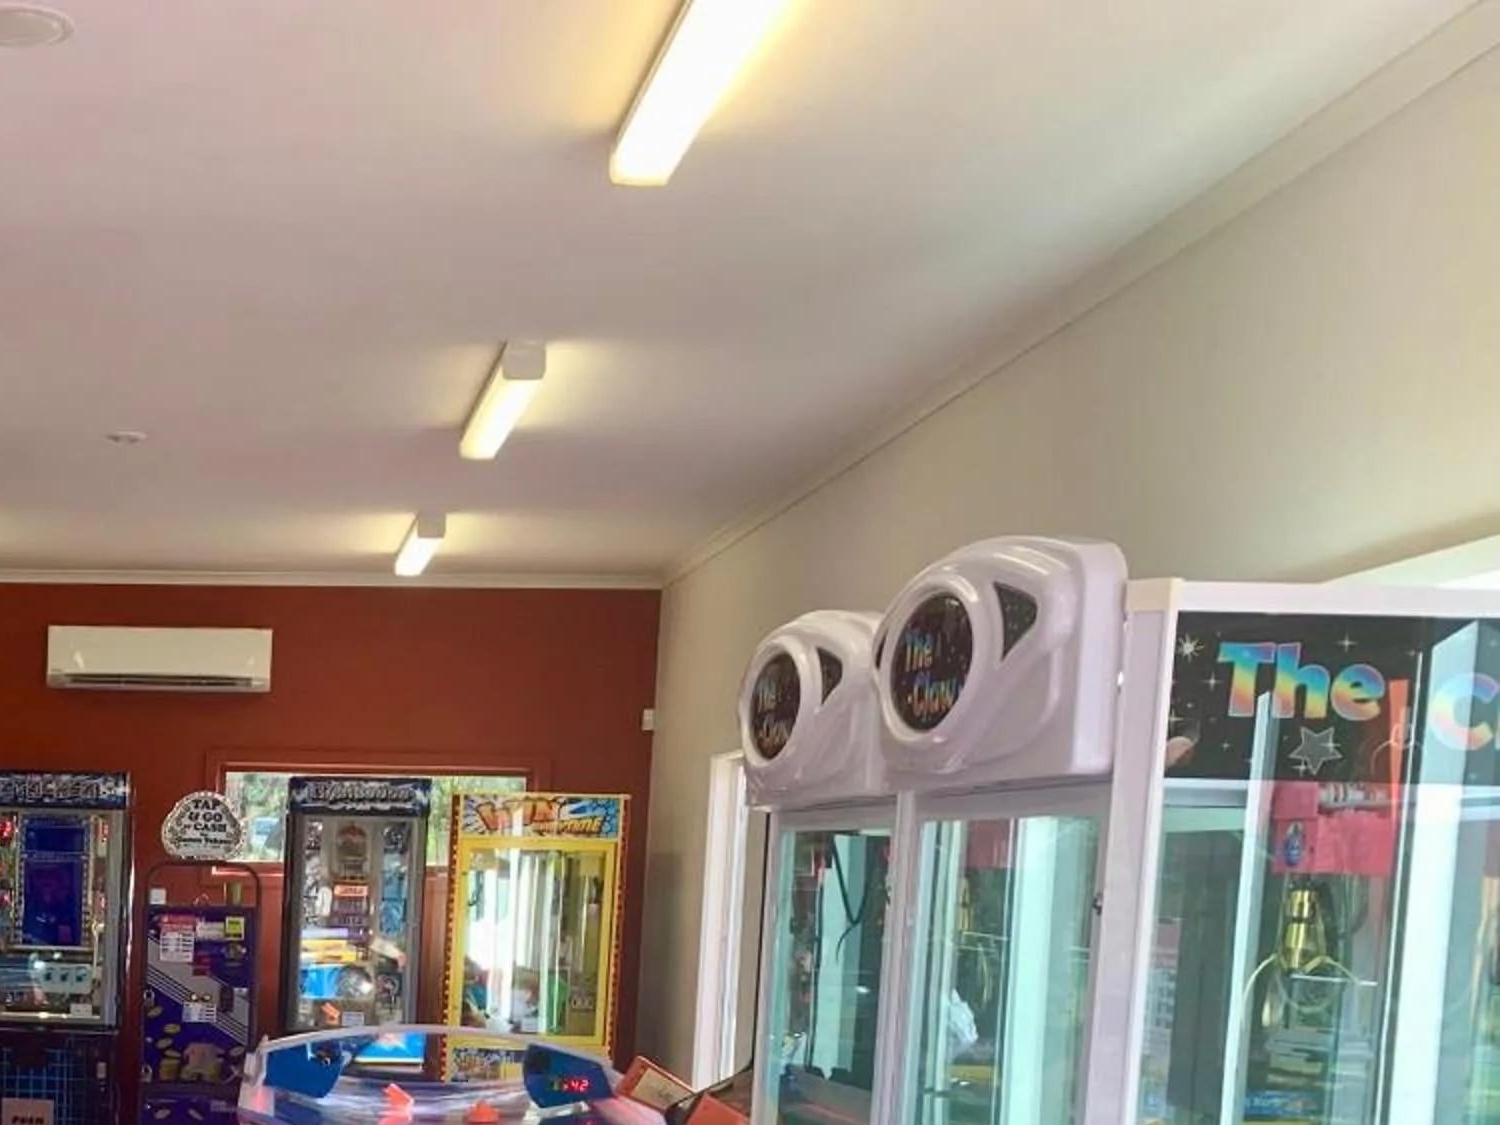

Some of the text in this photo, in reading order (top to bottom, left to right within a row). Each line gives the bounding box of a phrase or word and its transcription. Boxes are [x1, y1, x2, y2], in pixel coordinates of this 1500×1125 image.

[905, 626, 934, 673] The
[1217, 641, 1386, 721] The
[191, 799, 222, 810] TAP
[475, 796, 562, 831] WIN
[194, 822, 227, 833] CASH
[203, 811, 223, 822] GO
